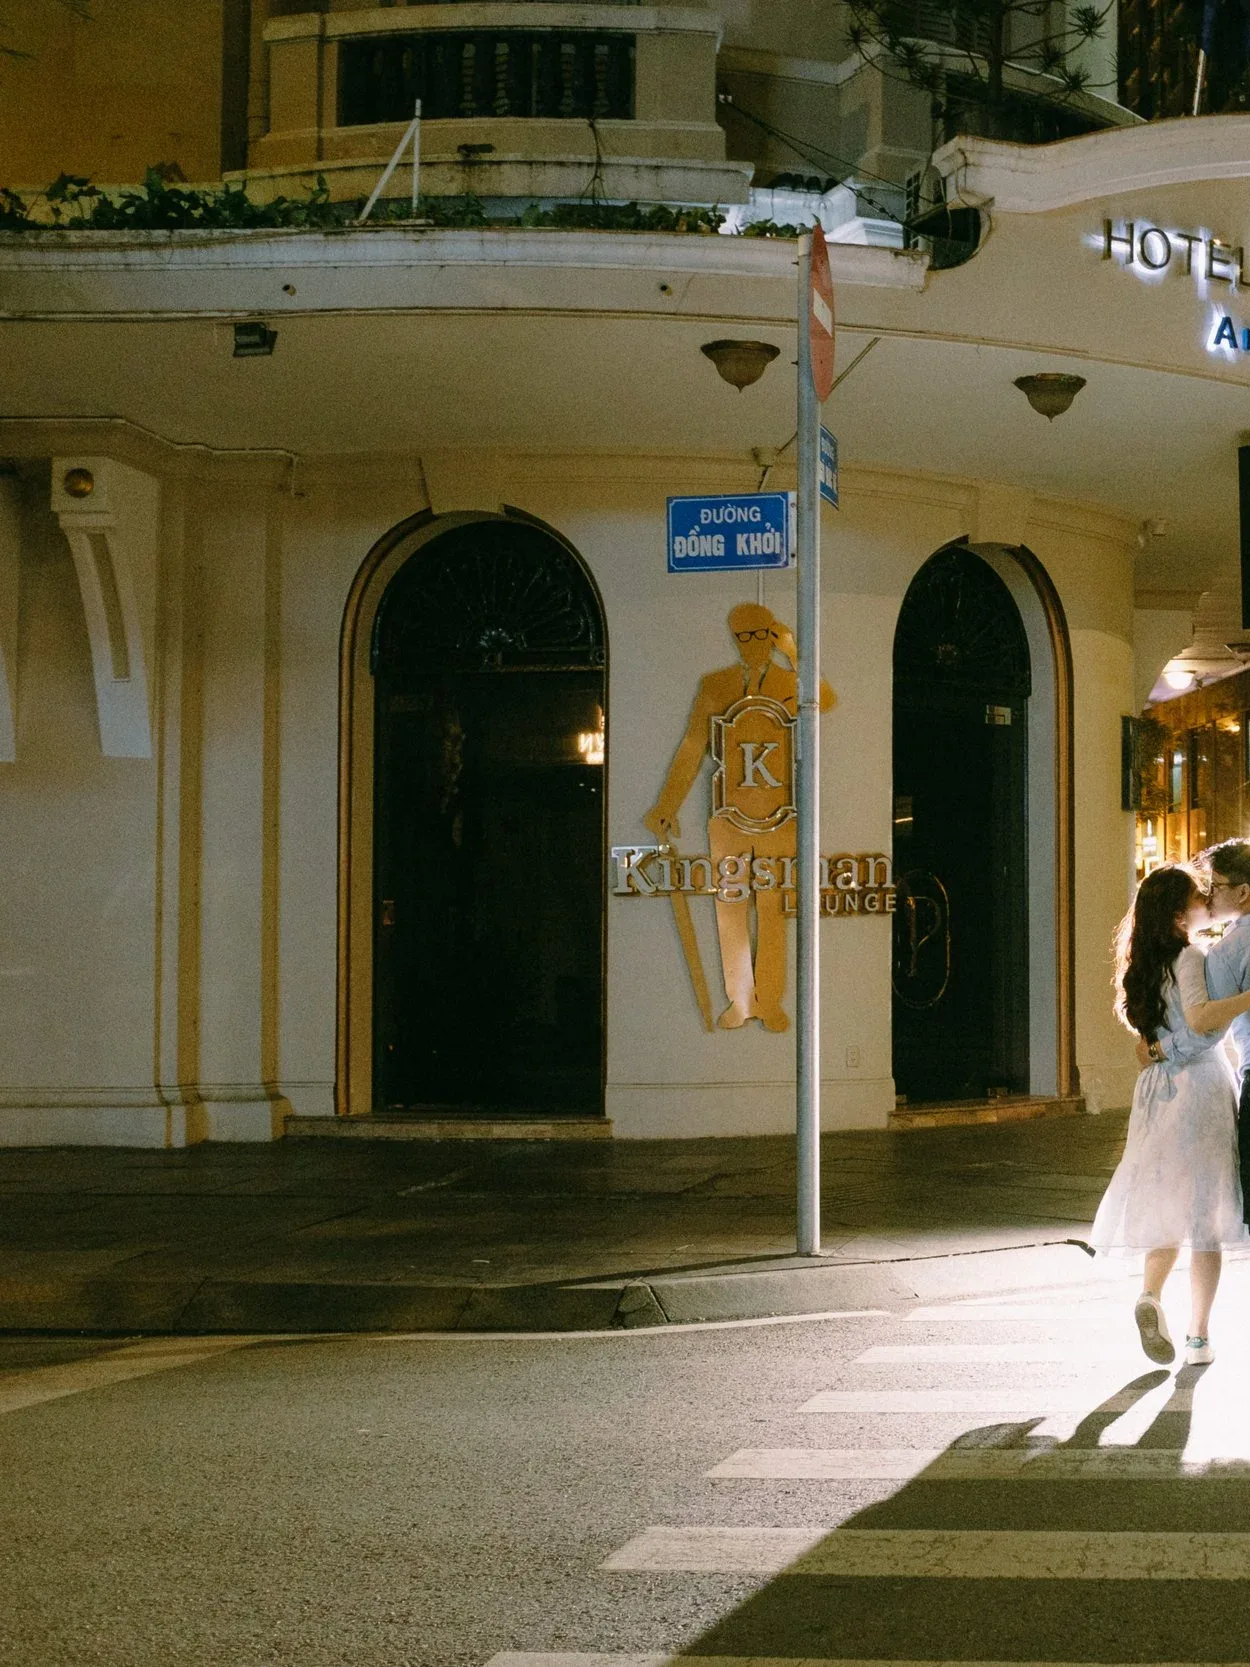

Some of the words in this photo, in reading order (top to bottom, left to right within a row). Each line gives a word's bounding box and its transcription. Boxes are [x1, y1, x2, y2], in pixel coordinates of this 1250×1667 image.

[1213, 315, 1239, 349] A
[700, 503, 762, 524] ĐƯỜNG
[674, 525, 725, 558] ĐỒNG
[736, 522, 781, 556] KHỞI
[738, 742, 782, 788] K
[784, 892, 897, 914] LUNGE
